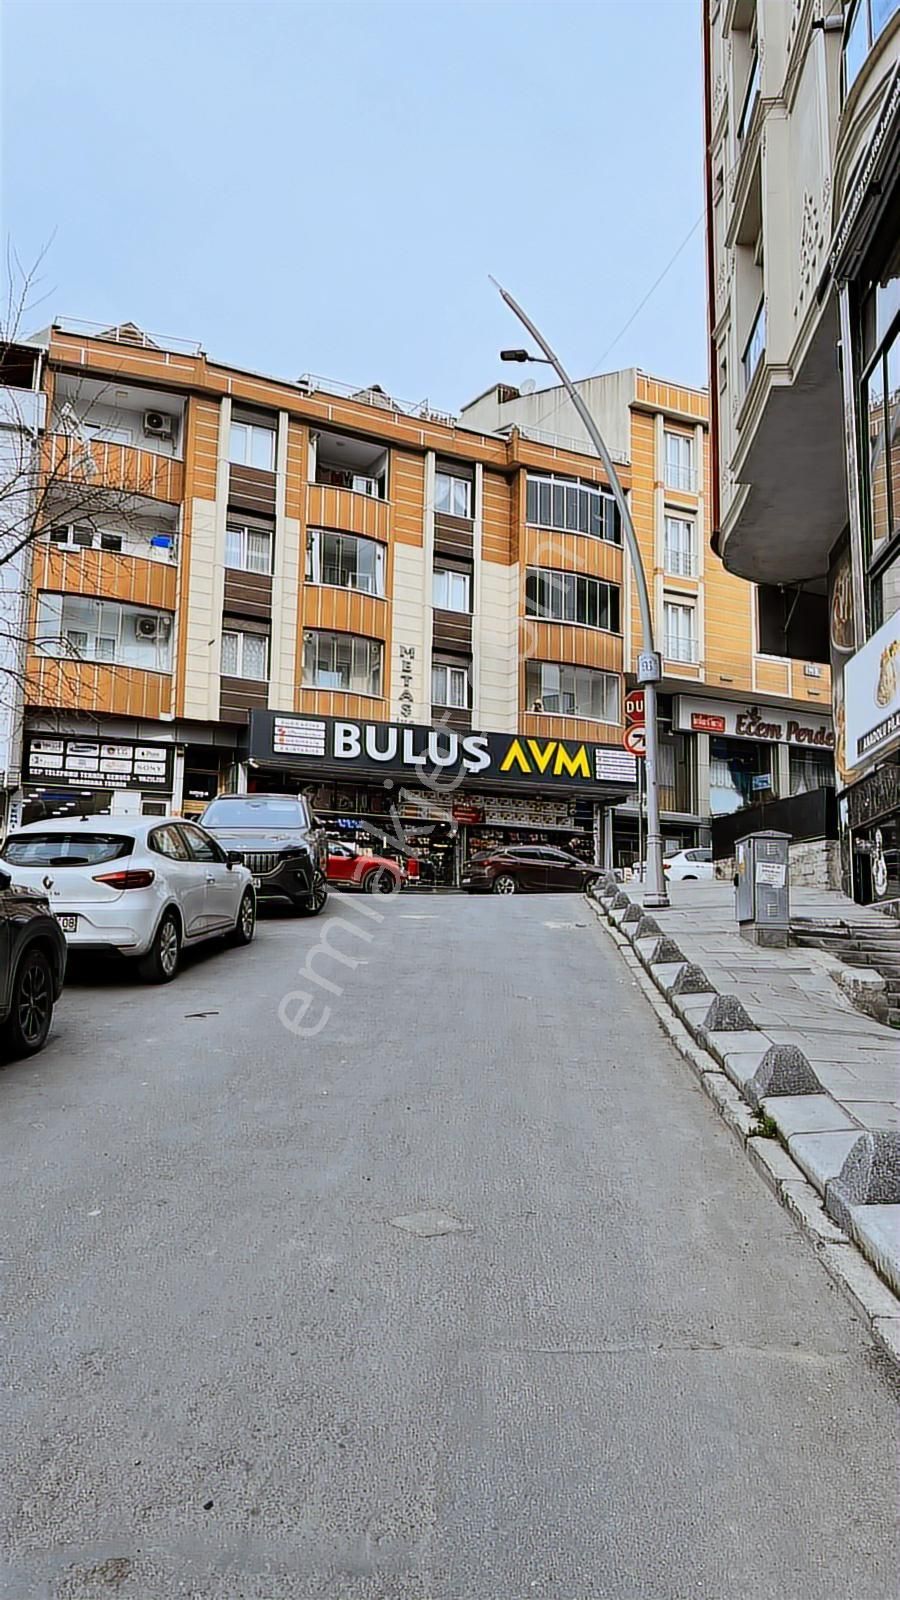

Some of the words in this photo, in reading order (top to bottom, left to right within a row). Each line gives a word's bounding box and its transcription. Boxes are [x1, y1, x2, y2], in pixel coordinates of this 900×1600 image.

[626, 701, 643, 713] DU
[735, 713, 783, 740] Ecem
[334, 721, 491, 773] BULUŞ
[500, 739, 591, 778] AVM
